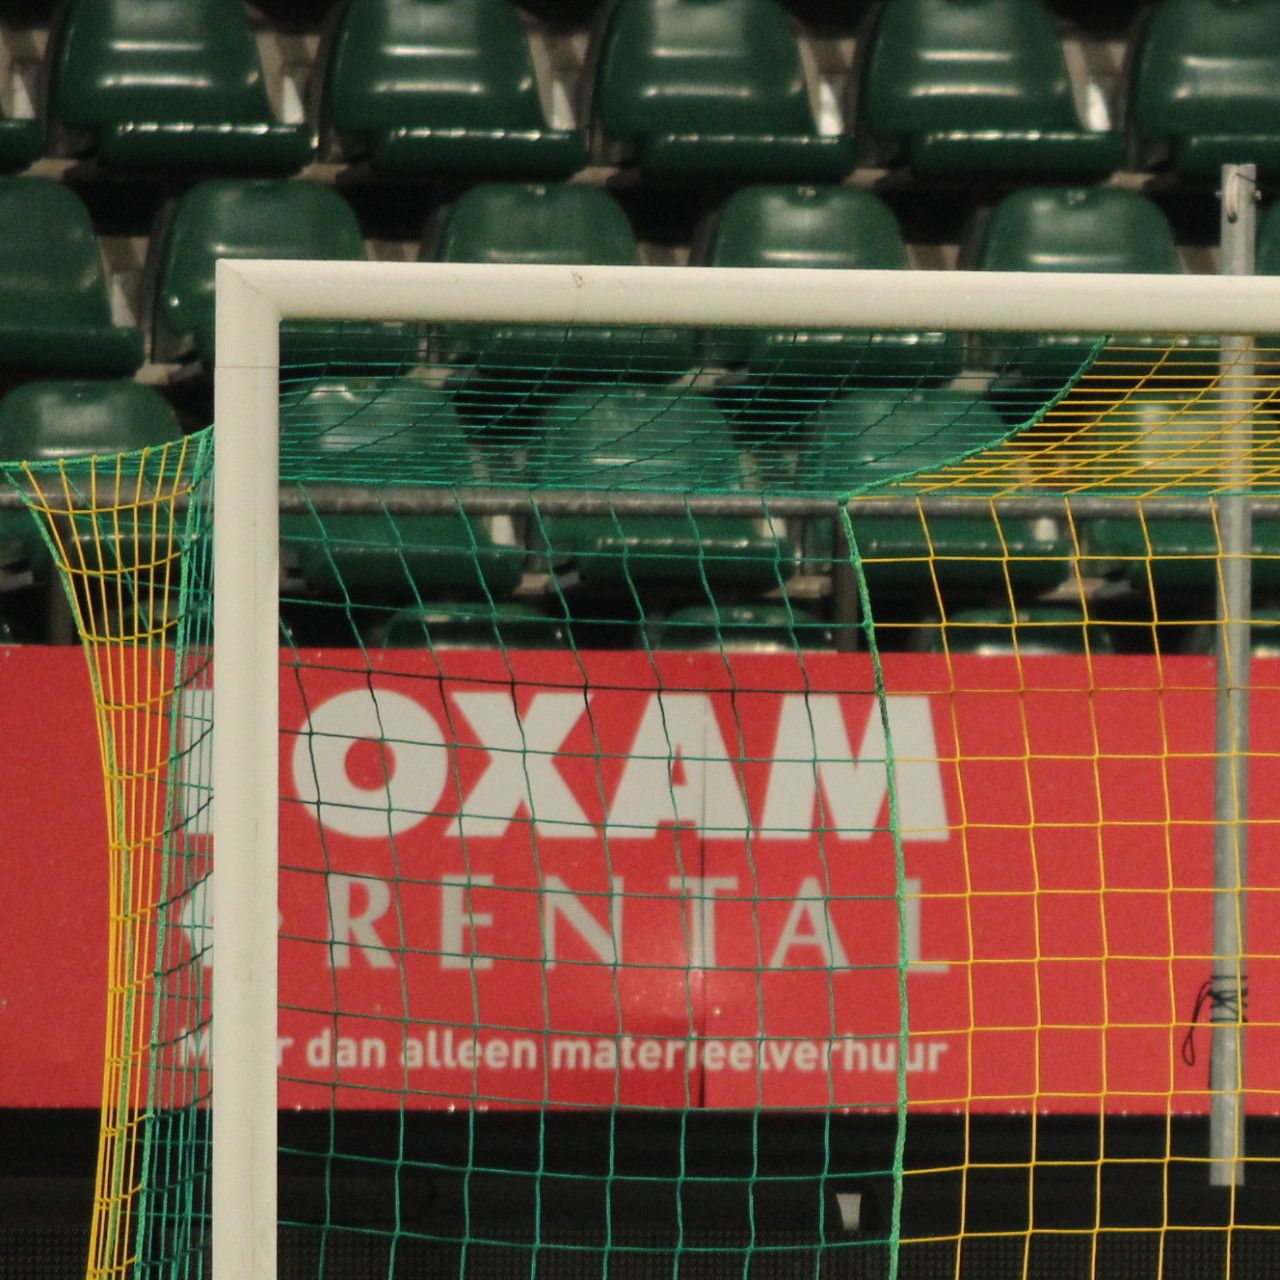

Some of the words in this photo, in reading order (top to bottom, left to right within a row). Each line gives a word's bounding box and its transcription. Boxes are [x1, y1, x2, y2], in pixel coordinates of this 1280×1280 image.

[325, 873, 950, 973] RENTAL
[306, 1029, 387, 1069] dan
[400, 1029, 543, 1070] alleen
[553, 1031, 949, 1073] materieelverhuur
